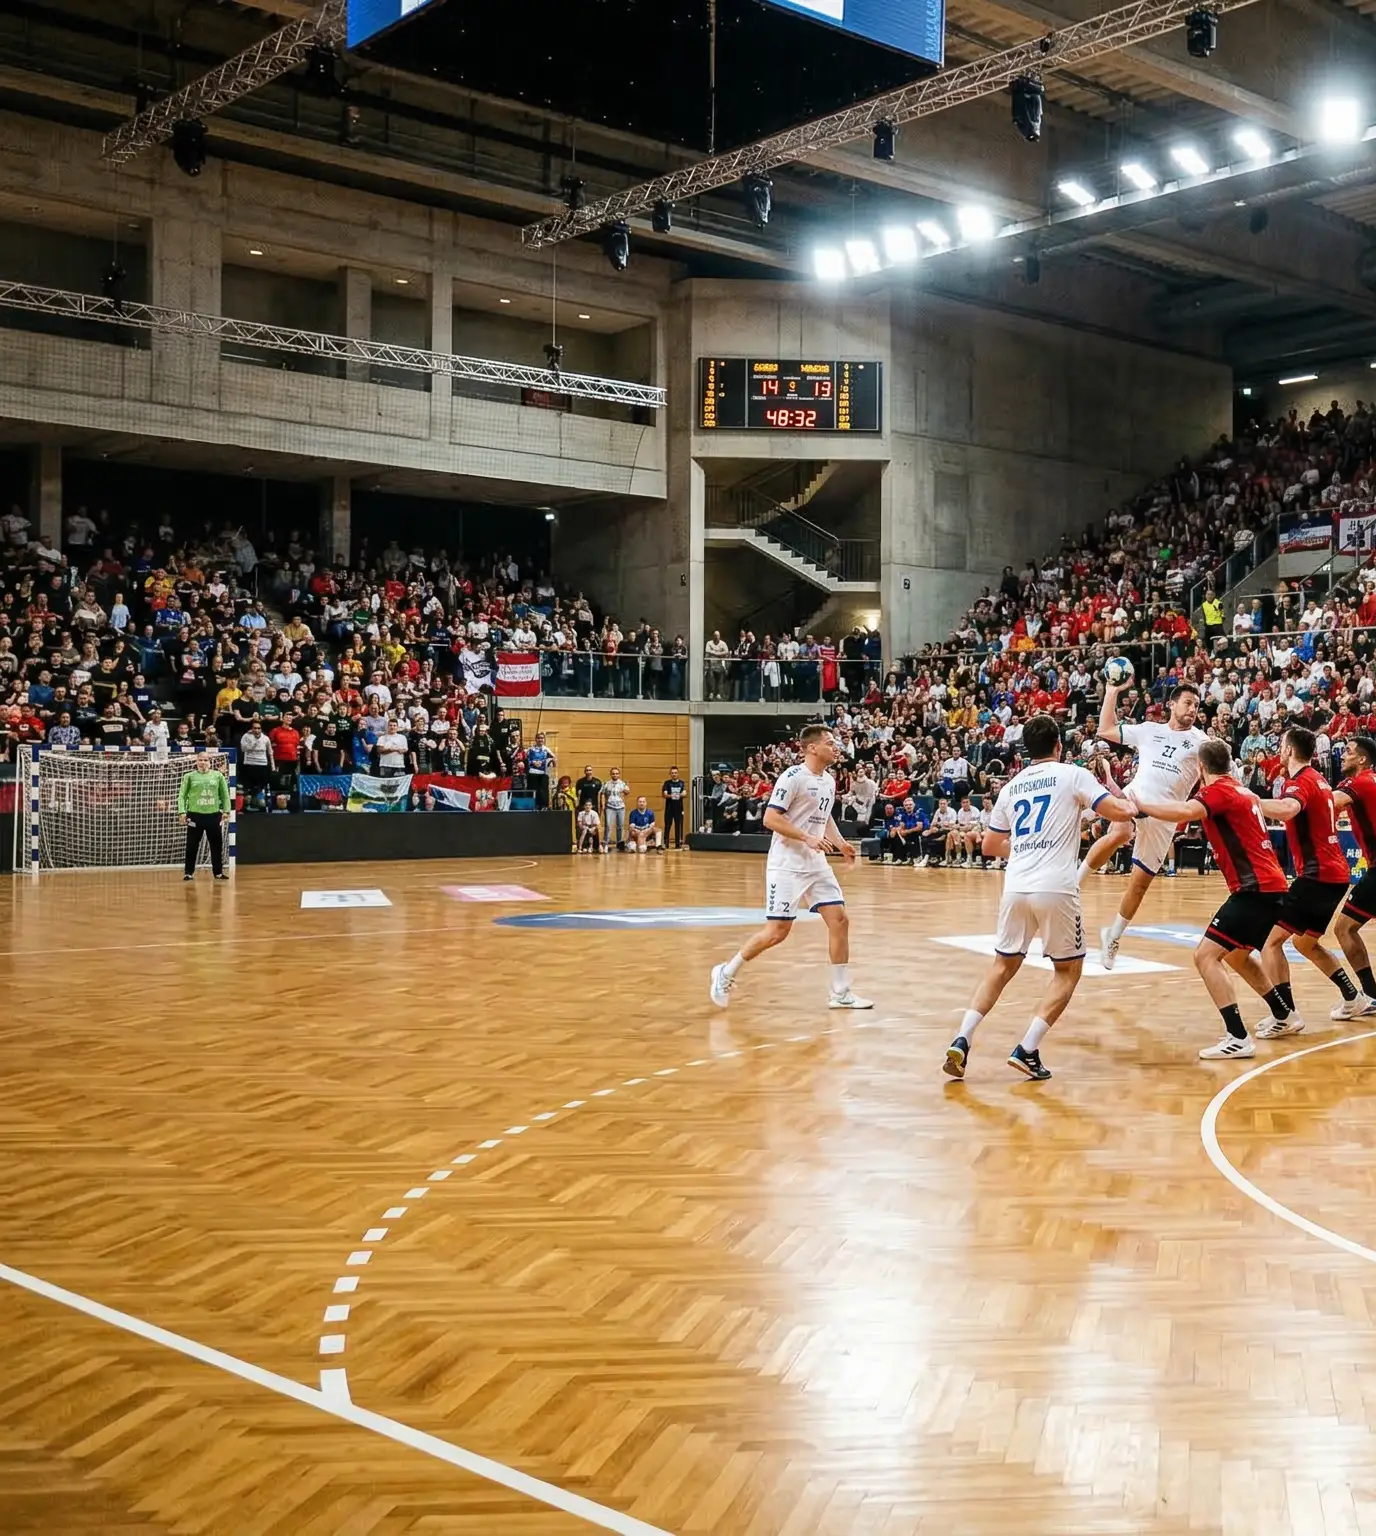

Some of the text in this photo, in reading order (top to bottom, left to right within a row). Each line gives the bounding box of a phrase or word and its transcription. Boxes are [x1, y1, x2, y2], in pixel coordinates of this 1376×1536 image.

[762, 380, 779, 395] 14
[814, 381, 831, 397] 13
[766, 409, 817, 427] 48:32
[1013, 793, 1052, 838] 27
